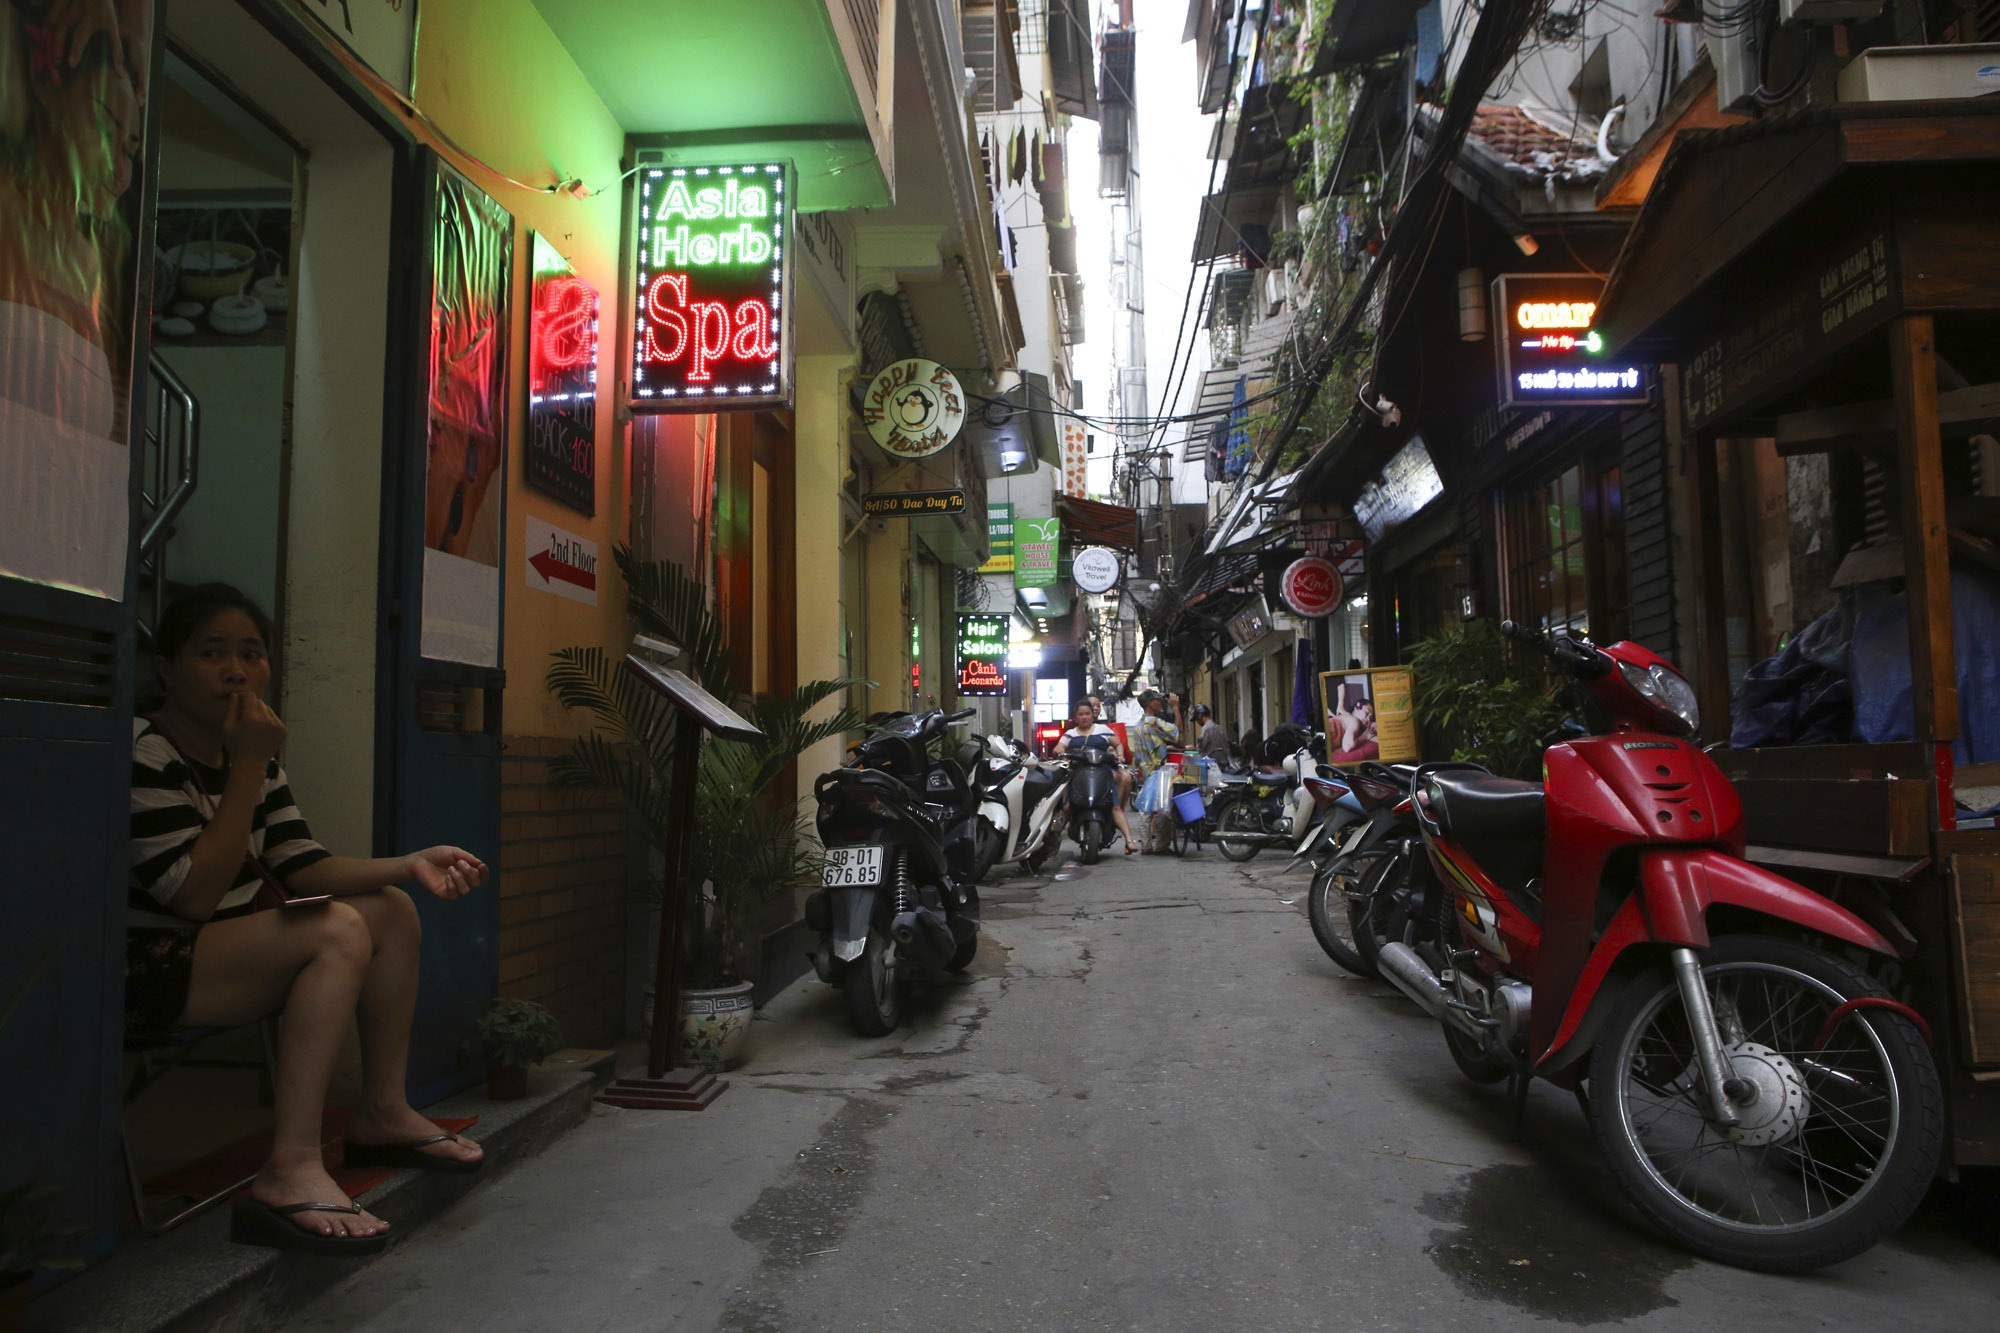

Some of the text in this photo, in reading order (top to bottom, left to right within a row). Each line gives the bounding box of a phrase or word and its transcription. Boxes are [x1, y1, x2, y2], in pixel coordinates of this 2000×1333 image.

[656, 179, 768, 220] Asia
[653, 223, 771, 267] Herb
[645, 274, 776, 381] Spa
[864, 363, 918, 426] Happy
[572, 435, 594, 480] 160
[902, 498, 923, 509] Dao
[926, 497, 947, 509] Duy
[949, 495, 963, 506] Tu
[551, 532, 597, 573] 2nd Floor
[1029, 560, 1054, 568] TRAVEL
[1082, 563, 1111, 572] Vitawell
[1085, 572, 1107, 581] Travel
[1462, 596, 1471, 615] 15
[967, 621, 999, 636] Hair
[962, 640, 1003, 655] Salon
[962, 670, 1004, 685] Leonardo
[1623, 742, 1678, 751] HONDA
[833, 849, 873, 866] 98-D1
[826, 866, 877, 885] 676.85
